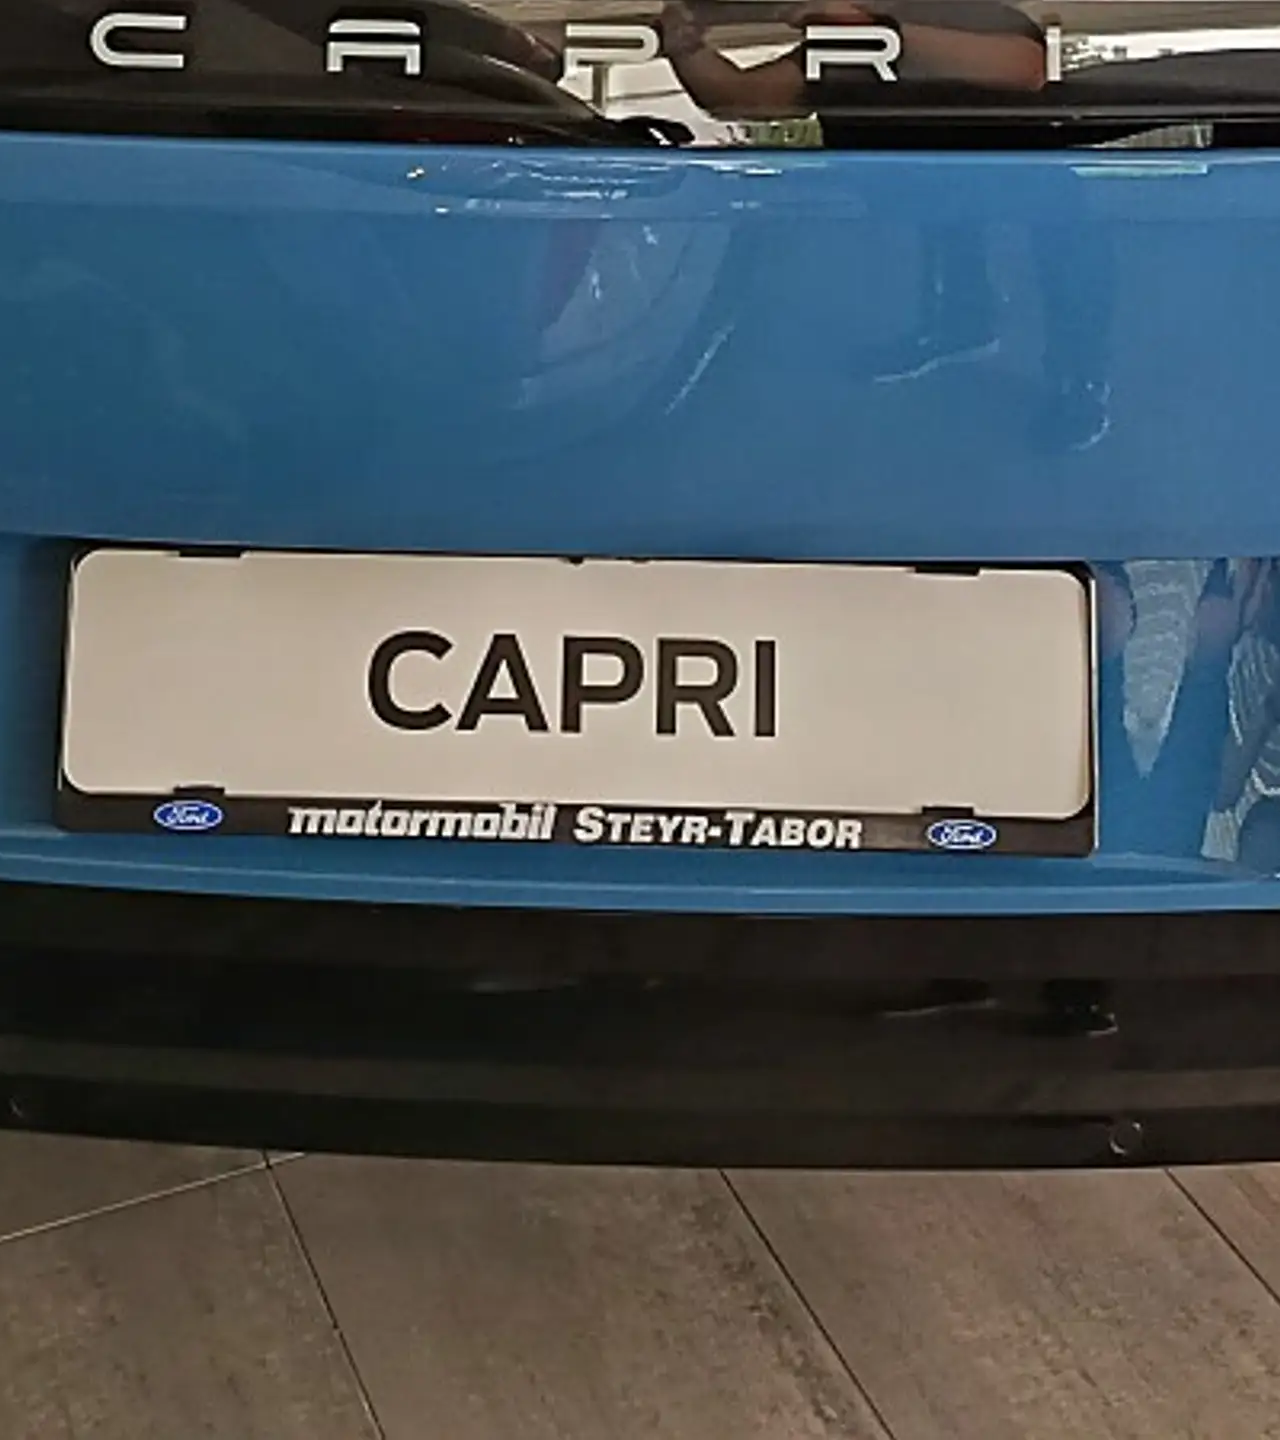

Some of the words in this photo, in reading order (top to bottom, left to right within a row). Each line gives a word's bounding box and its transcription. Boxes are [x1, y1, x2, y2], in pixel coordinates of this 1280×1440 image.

[88, 11, 1063, 83] CAPRI
[367, 629, 777, 738] CAPRI
[287, 800, 558, 841] motormobil
[573, 805, 864, 850] STEYR-TABOR
